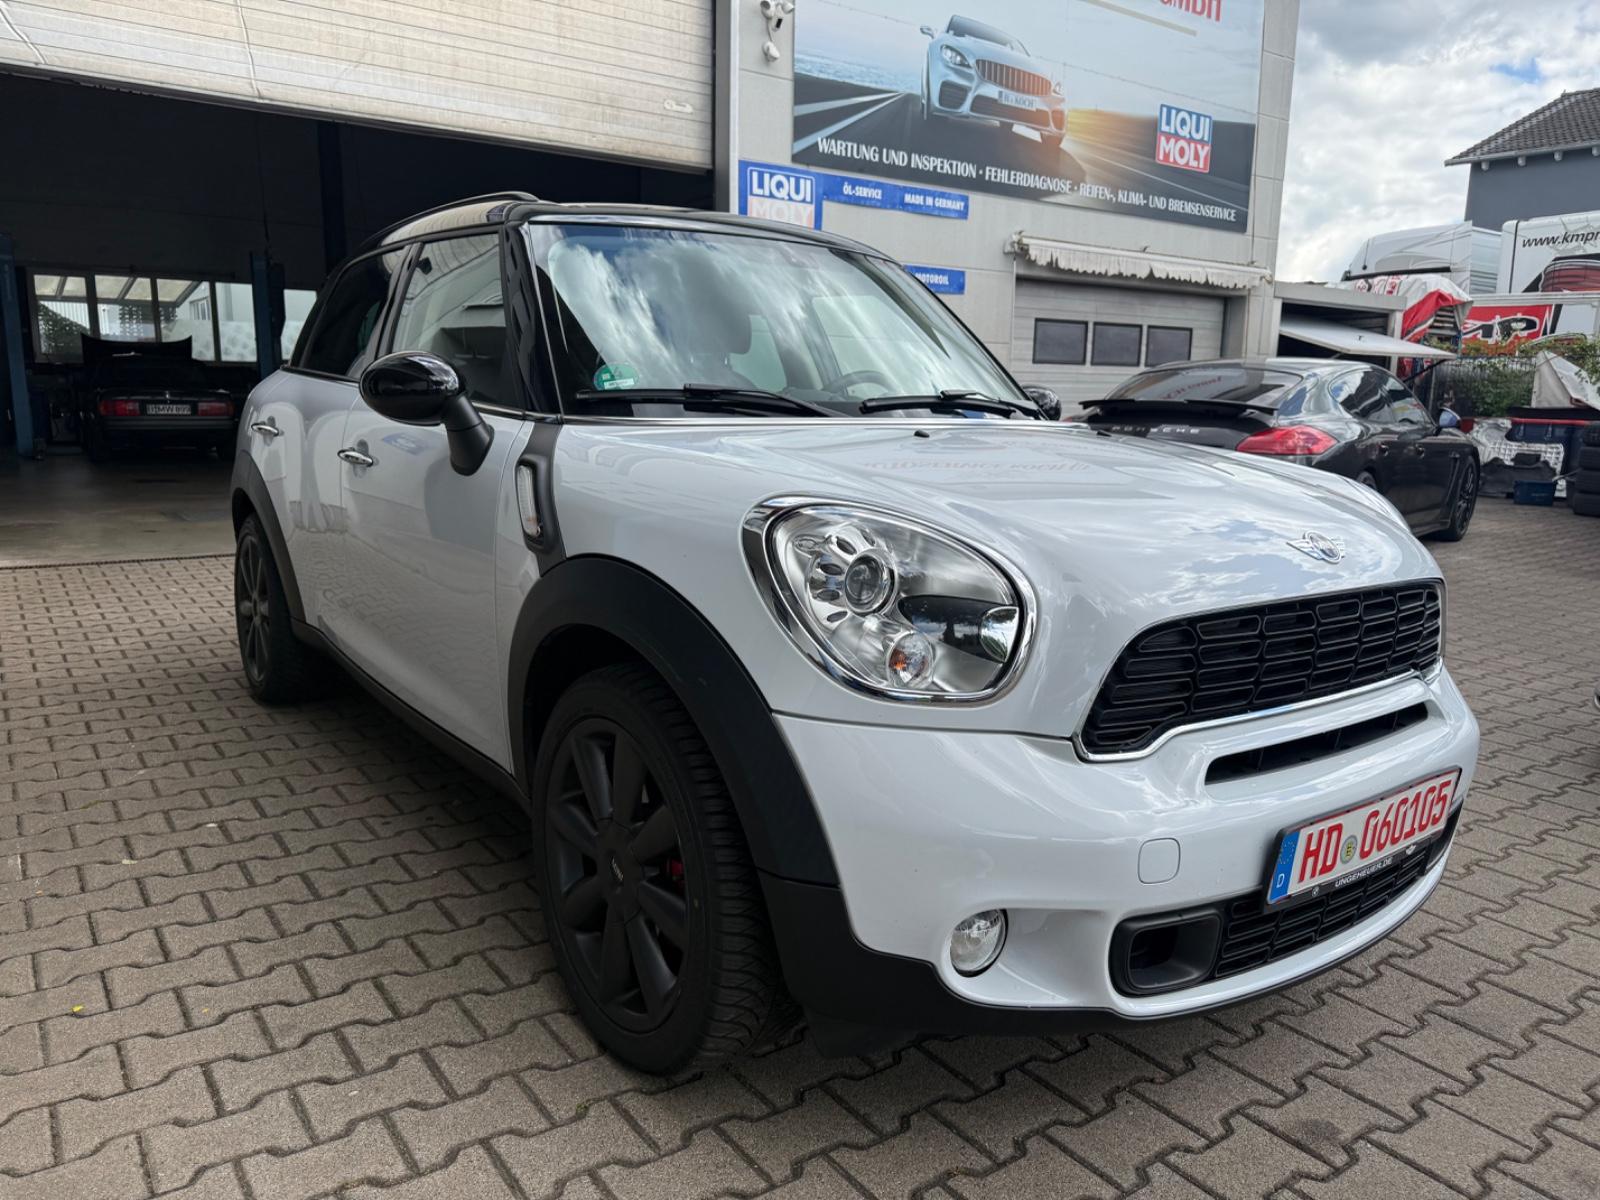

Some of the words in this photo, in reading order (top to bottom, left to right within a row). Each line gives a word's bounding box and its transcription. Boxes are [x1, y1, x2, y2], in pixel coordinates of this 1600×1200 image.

[1161, 107, 1210, 142] LIQUI
[1159, 136, 1210, 169] MOLY
[752, 171, 812, 202] LIQUI
[817, 136, 879, 163] WARTUNG
[882, 148, 908, 167] UND
[910, 153, 977, 179] INSPEKTION
[985, 166, 1072, 193] FEHLERDIAGNOSE
[1118, 189, 1147, 206] KLIMA-
[1149, 195, 1167, 210] UND
[1168, 198, 1237, 222] BREMSENSERVICE
[904, 193, 924, 205] MADE
[925, 196, 933, 206] IN
[934, 197, 965, 211] GERMANY
[1298, 822, 1344, 883] HD
[1359, 779, 1452, 860] 060105
[1276, 873, 1285, 888] D
